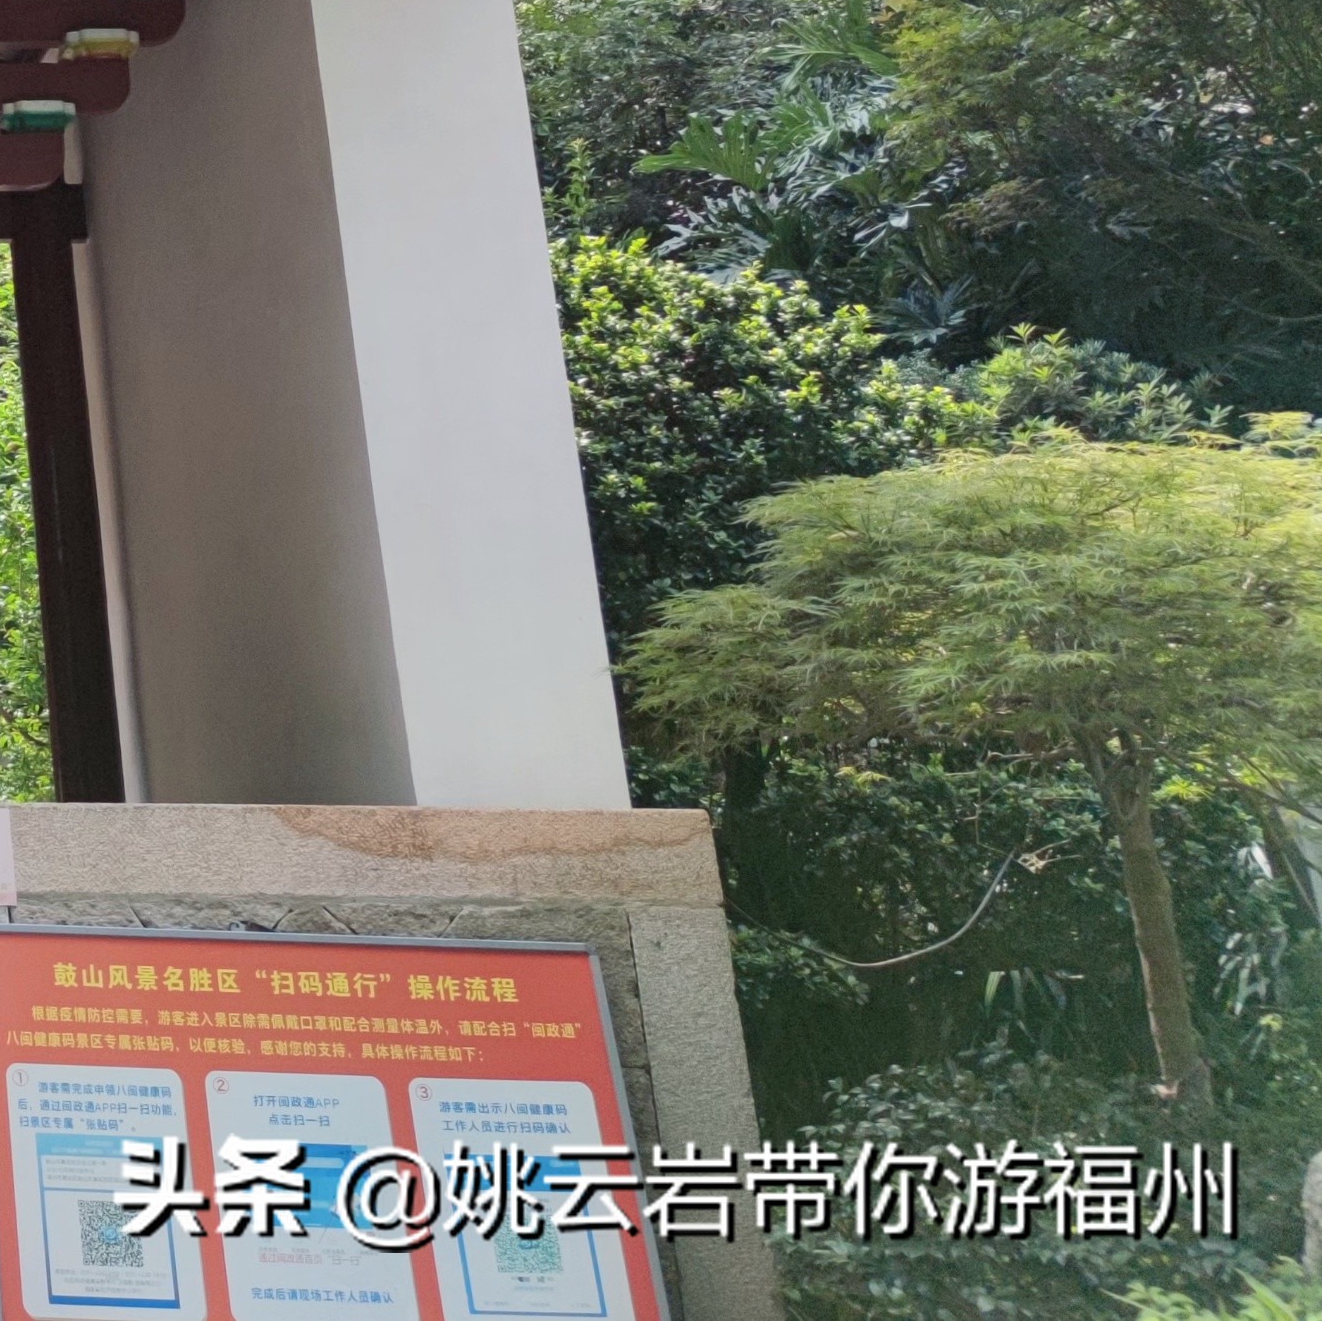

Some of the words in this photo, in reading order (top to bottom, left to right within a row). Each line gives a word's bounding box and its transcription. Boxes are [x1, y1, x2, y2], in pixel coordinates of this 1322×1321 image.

[252, 1094, 340, 1109] 打开闽政通APP
[268, 1113, 331, 1127] 点击扫一扫
[442, 1120, 571, 1135] 工作人员进行扫码确认
[250, 1287, 394, 1304] 完成后请现场工作人员确认
